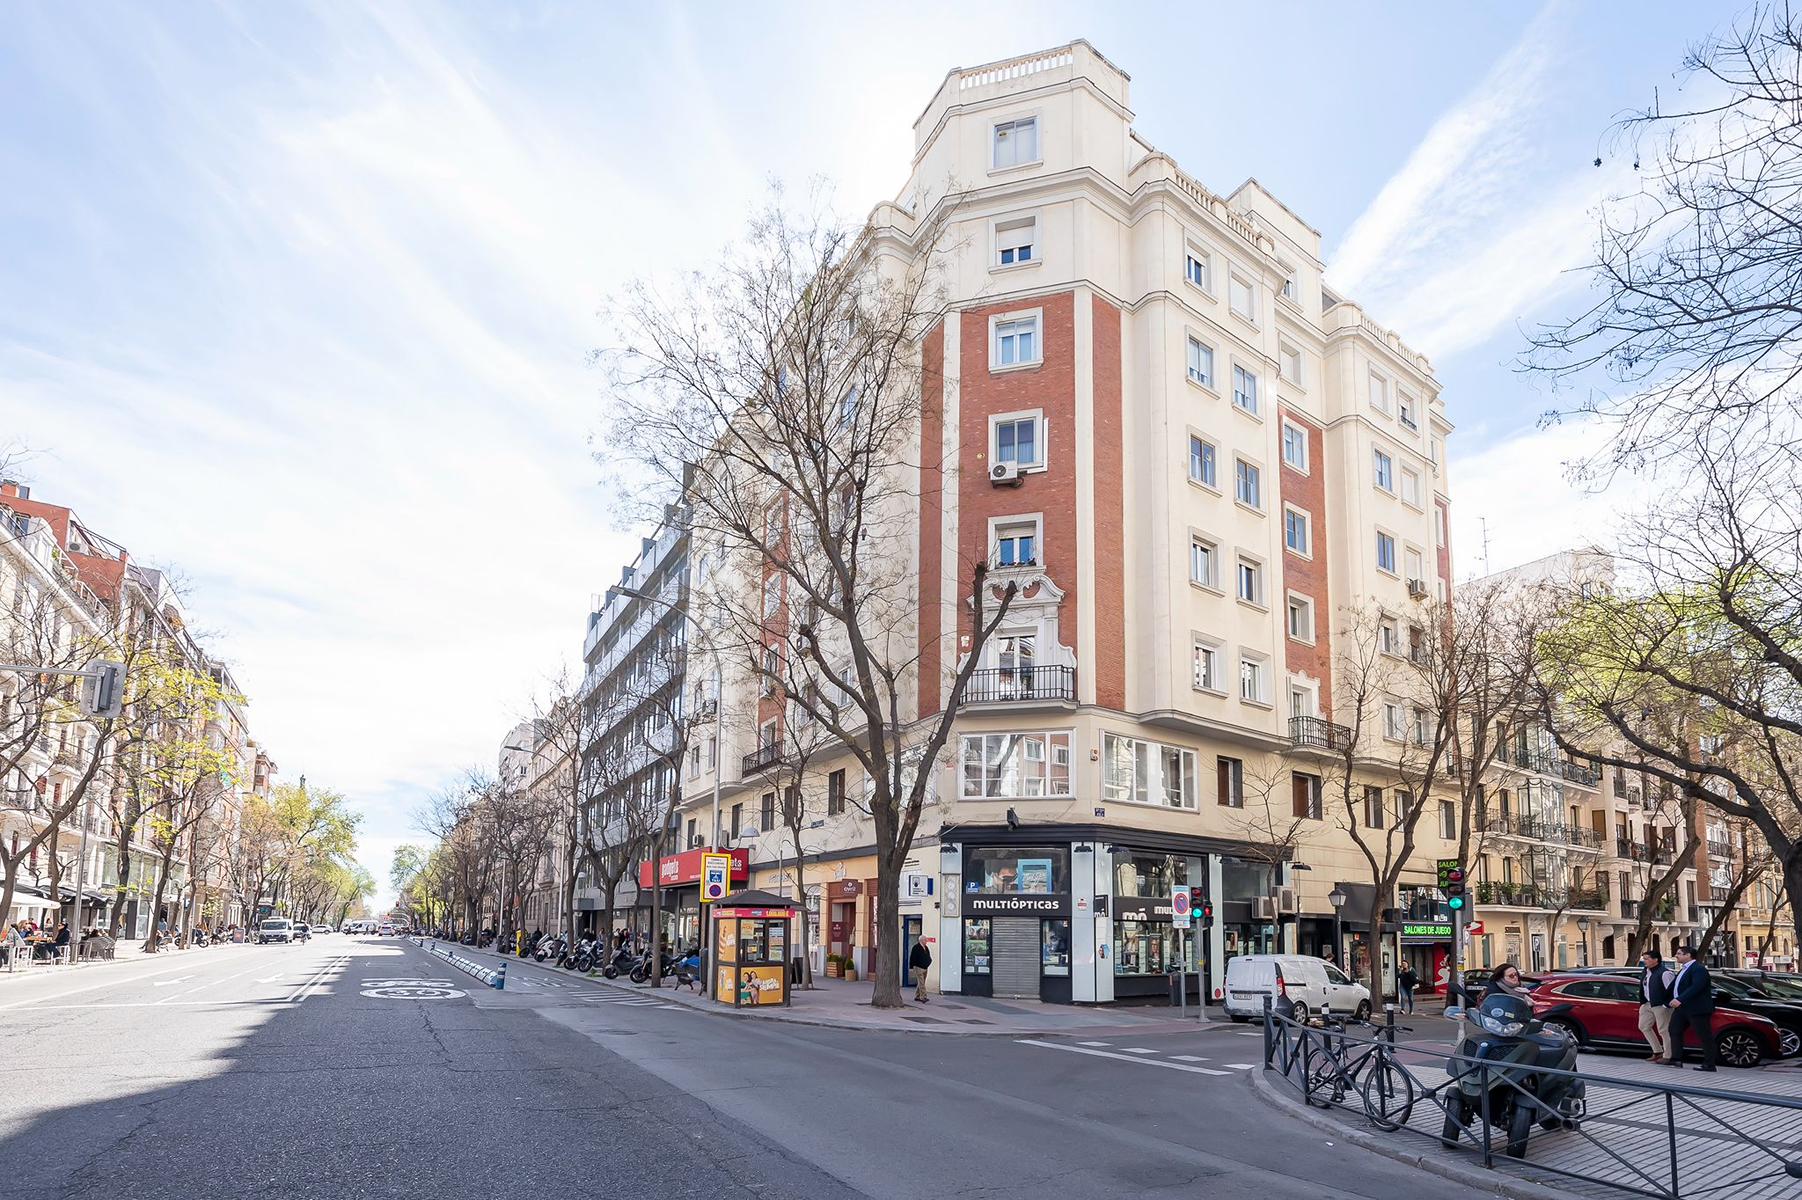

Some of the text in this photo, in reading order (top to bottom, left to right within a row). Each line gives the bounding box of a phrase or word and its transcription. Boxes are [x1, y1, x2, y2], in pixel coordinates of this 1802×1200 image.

[1403, 925, 1452, 935] SALONES DE JUEGO
